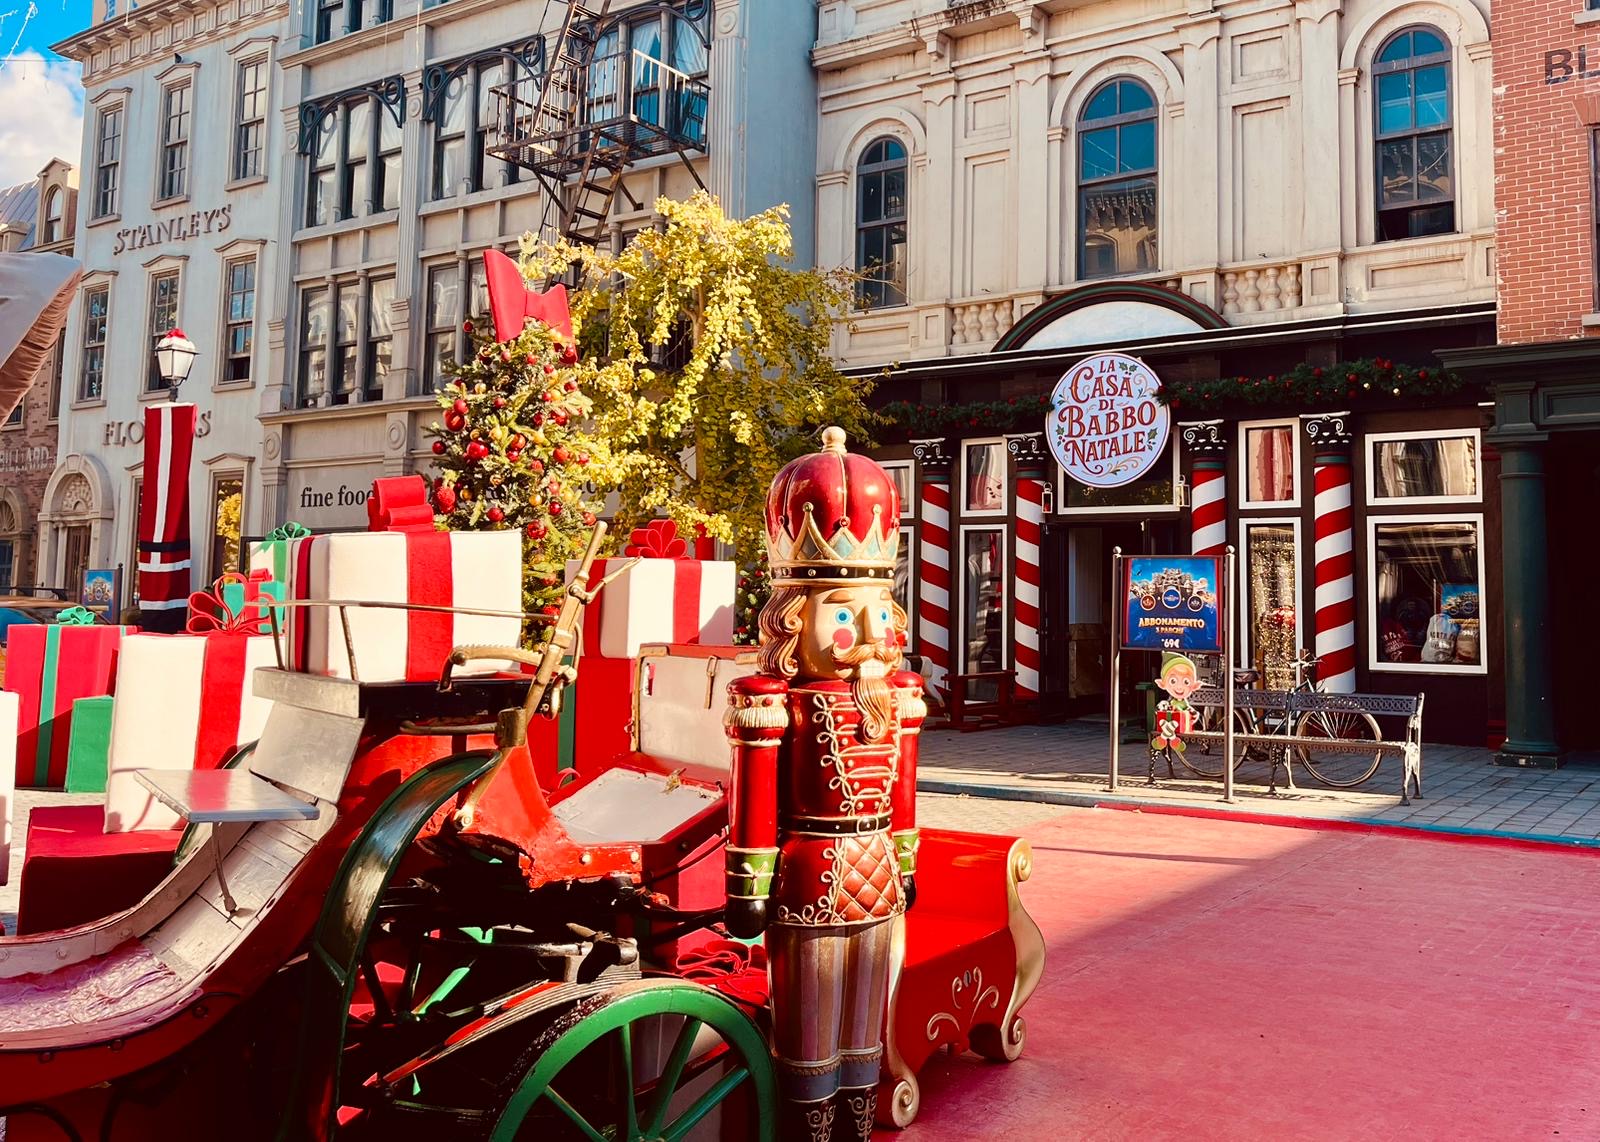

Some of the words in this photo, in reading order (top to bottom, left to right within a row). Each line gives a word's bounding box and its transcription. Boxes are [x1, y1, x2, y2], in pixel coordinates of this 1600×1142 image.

[113, 204, 231, 256] STANLEY'S
[1069, 366, 1133, 403] CASA
[1100, 360, 1115, 373] LA
[1058, 401, 1156, 438] BABBO
[1098, 399, 1115, 411] DI
[103, 410, 211, 447] FLOS
[1064, 431, 1146, 474] NATALE
[300, 487, 333, 508] fine
[1138, 617, 1205, 629] ABBONAMENTO
